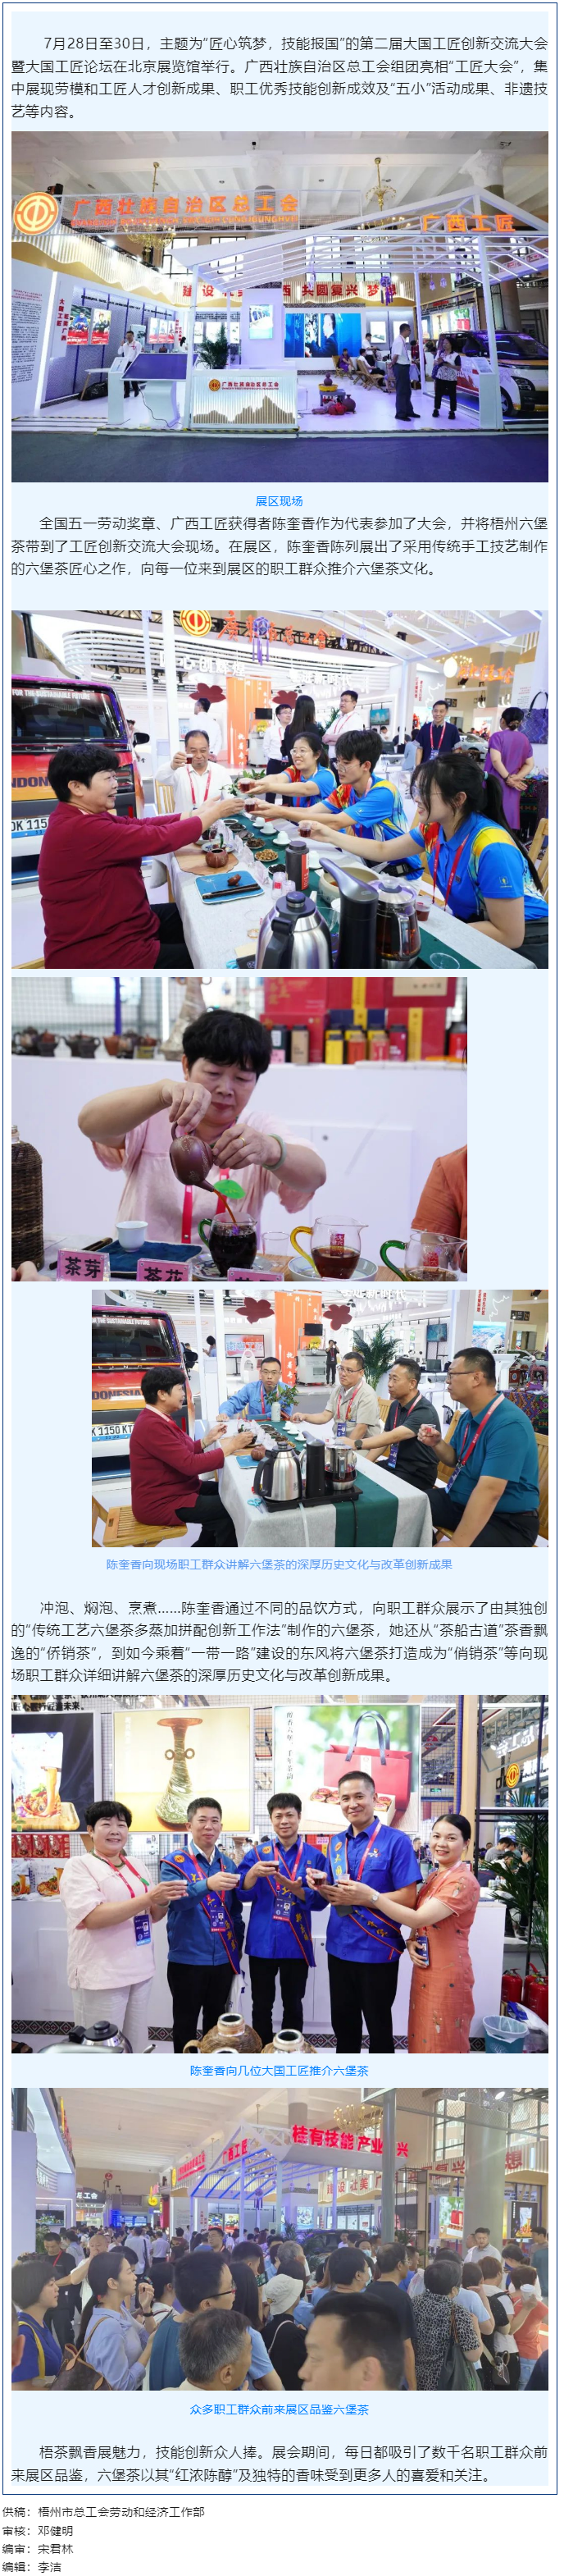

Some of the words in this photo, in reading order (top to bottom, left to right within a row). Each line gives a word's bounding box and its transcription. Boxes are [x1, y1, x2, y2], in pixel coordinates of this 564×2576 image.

[11, 104, 74, 118] 艺等内容。
[72, 194, 298, 216] 广西壮族自治区总工会
[422, 214, 516, 232] 广西工匠
[39, 516, 548, 531] 全国五一劳动奖章、广西工匠获得者陈奎香作为代表参加了大会，并将梧州六堡
[11, 539, 548, 554] 茶带到了工匠创新交流大会现场。在展区，陈奎香陈列展出了采用传统手工技艺制作
[11, 561, 433, 575] 的六堡茶匠心之作，向每一位来到展区的职工群众推介六堡茶文化。
[11, 776, 51, 788] NDON
[65, 1256, 101, 1279] 茶芽
[98, 1426, 120, 1436] 1150
[11, 1668, 390, 1682] 场职工群众详细讲解六堡茶的深厚历史文化与改革创新成果。
[292, 2124, 354, 2150] 桂有技能
[357, 2135, 408, 2158] 产业兴
[39, 2445, 548, 2459] 梧茶飘香展魅力，技能创新众人捧。展会期间，每日都吸引了数千名职工群众前
